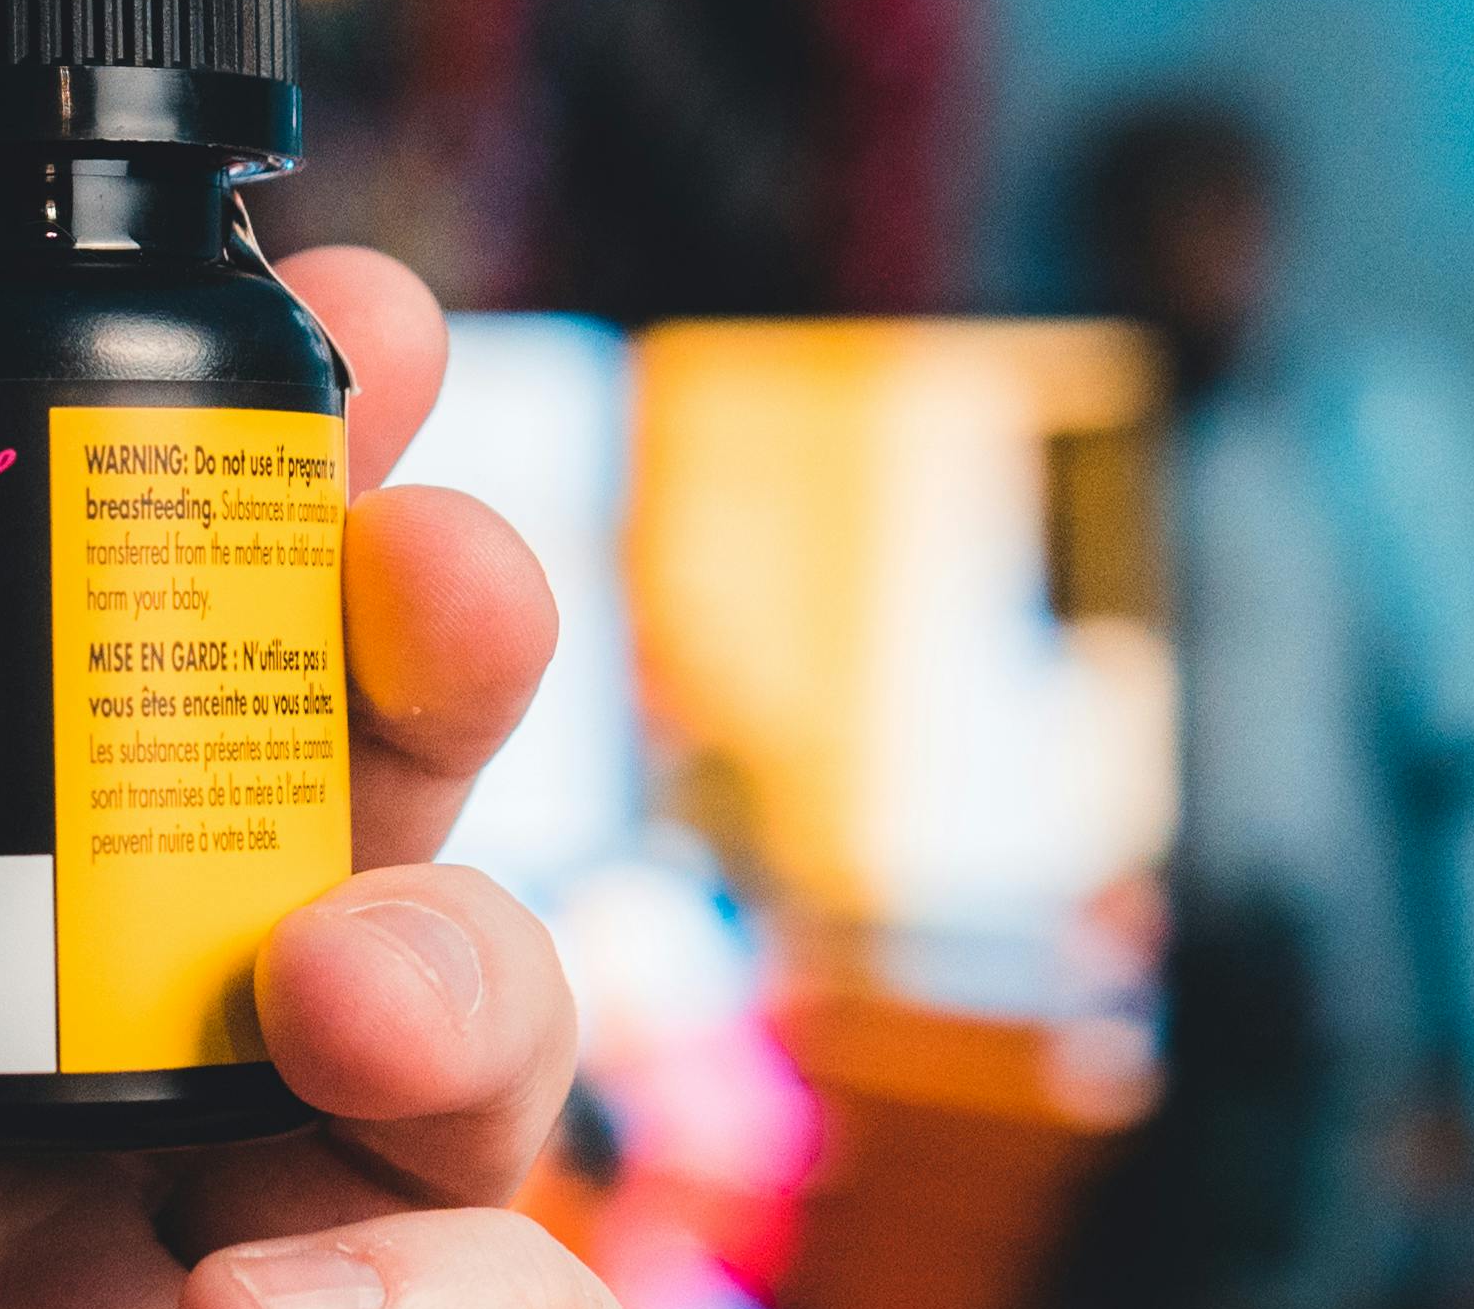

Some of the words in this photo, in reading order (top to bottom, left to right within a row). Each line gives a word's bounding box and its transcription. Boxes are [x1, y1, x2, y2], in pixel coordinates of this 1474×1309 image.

[84, 444, 188, 476] WARNING:
[194, 445, 216, 476] Do
[222, 449, 246, 477] not
[250, 454, 273, 477] use
[276, 444, 285, 477] if
[288, 453, 328, 488] pregnant
[86, 487, 217, 529] breastfeeding.
[222, 489, 284, 522] Substances
[287, 490, 296, 522] in
[86, 531, 169, 566] transferred
[175, 531, 206, 566] from
[211, 531, 230, 566] the
[234, 532, 273, 566] mother
[276, 538, 286, 566] to
[288, 533, 310, 566] child
[86, 577, 128, 611] harm
[134, 590, 167, 621] your
[172, 577, 212, 621] baby.
[88, 642, 133, 673] MISE
[141, 642, 164, 672] EN
[171, 641, 228, 672] GARDE
[303, 646, 319, 681] pas
[321, 640, 328, 672] si
[89, 695, 134, 719] vous
[141, 686, 176, 718] êtes
[183, 683, 247, 717] enceinte
[253, 693, 269, 717] ou
[273, 693, 299, 717] vous
[89, 733, 113, 765] Les
[120, 729, 199, 764] substances
[204, 731, 261, 774] présentes
[265, 726, 290, 762] dans
[292, 726, 301, 761] le
[91, 781, 123, 810] sont
[128, 778, 204, 809] transmises
[208, 772, 225, 808] de
[229, 771, 241, 807] la
[245, 773, 273, 806] mère
[276, 774, 284, 805] à
[91, 826, 153, 865] peuvent
[158, 824, 195, 854] nuire
[199, 821, 208, 853] à
[212, 826, 244, 851] votre
[248, 817, 281, 851] bébé.
